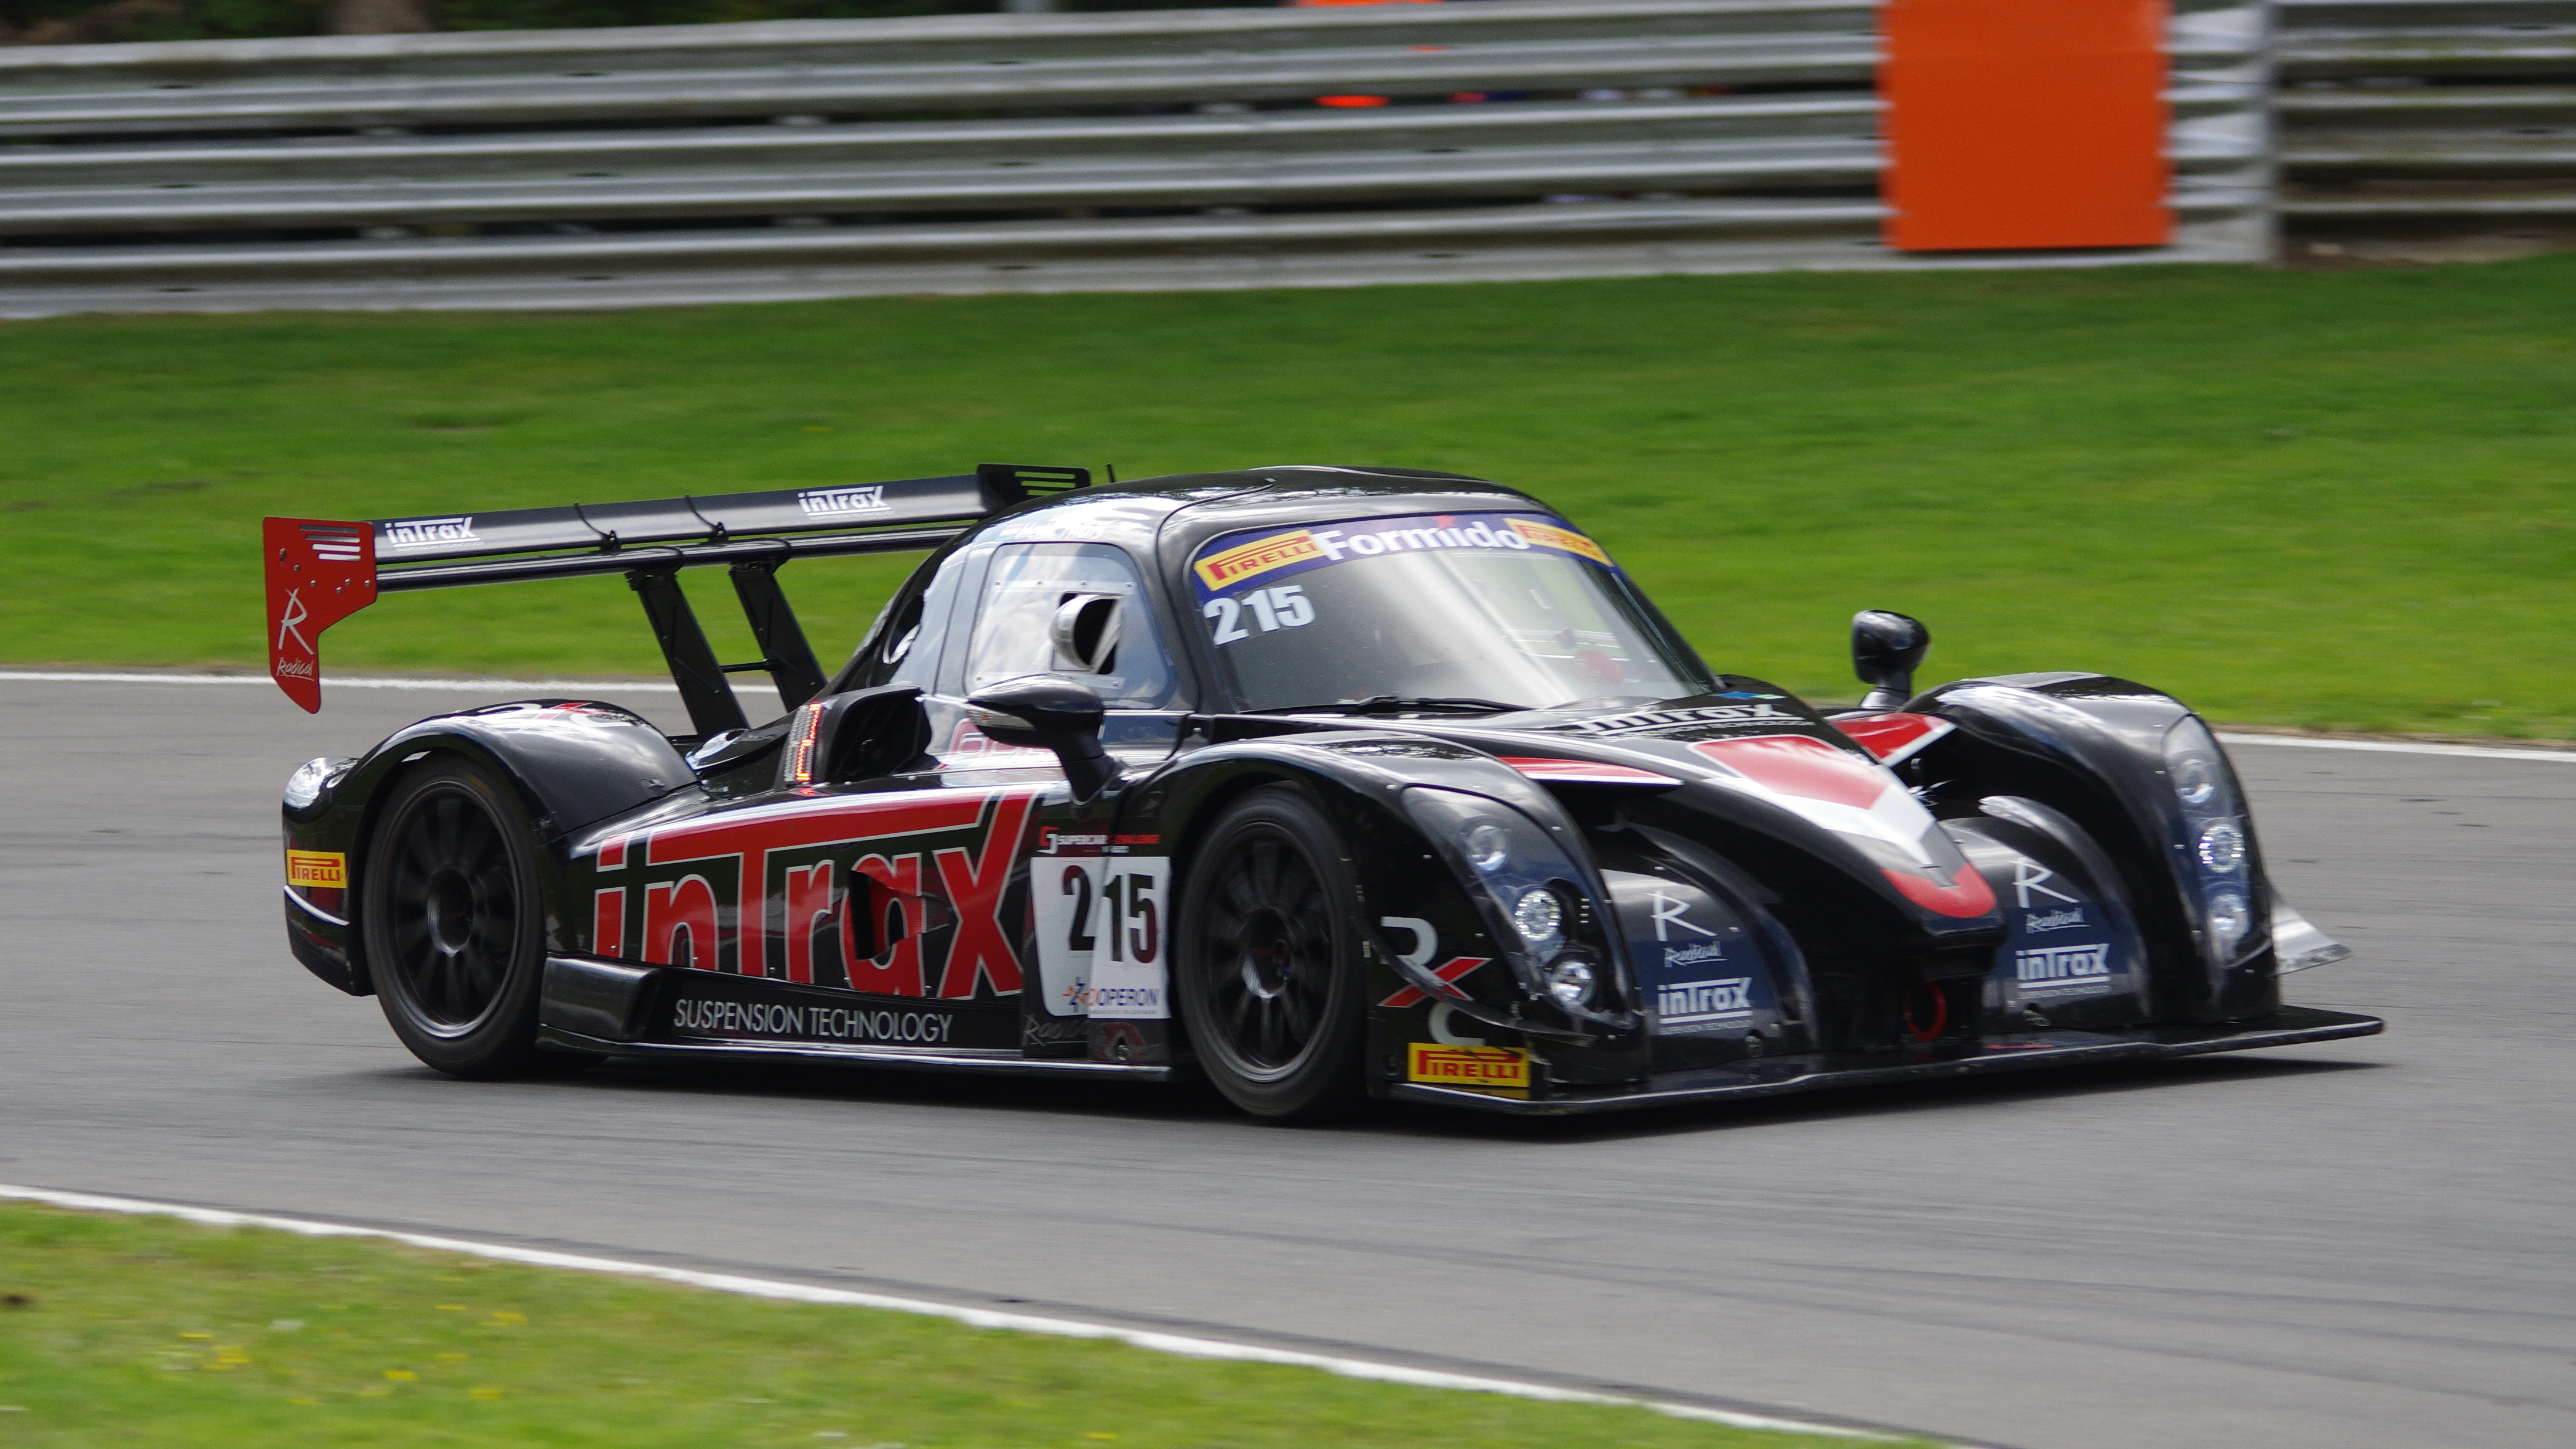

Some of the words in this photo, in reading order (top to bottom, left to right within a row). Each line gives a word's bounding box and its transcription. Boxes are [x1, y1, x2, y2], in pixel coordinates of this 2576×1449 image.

[797, 486, 889, 513] inTrax
[385, 517, 477, 544] inTrax
[1311, 520, 1531, 561] Formido
[1207, 536, 1318, 581] PIRELLI
[277, 587, 314, 656] R
[1203, 585, 1315, 646] 215
[290, 857, 341, 881] PIRELLI
[2007, 857, 2080, 908] R
[593, 788, 1043, 999] inTrax
[1062, 864, 1158, 963] 215
[1643, 890, 1718, 941] R
[2015, 943, 2111, 980] inTrax
[1657, 977, 1753, 1016] inTrax
[674, 999, 804, 1034] SUSPENSION
[809, 1007, 953, 1043] TECHNOLOGY
[1416, 1050, 1520, 1080] PIRELLI
